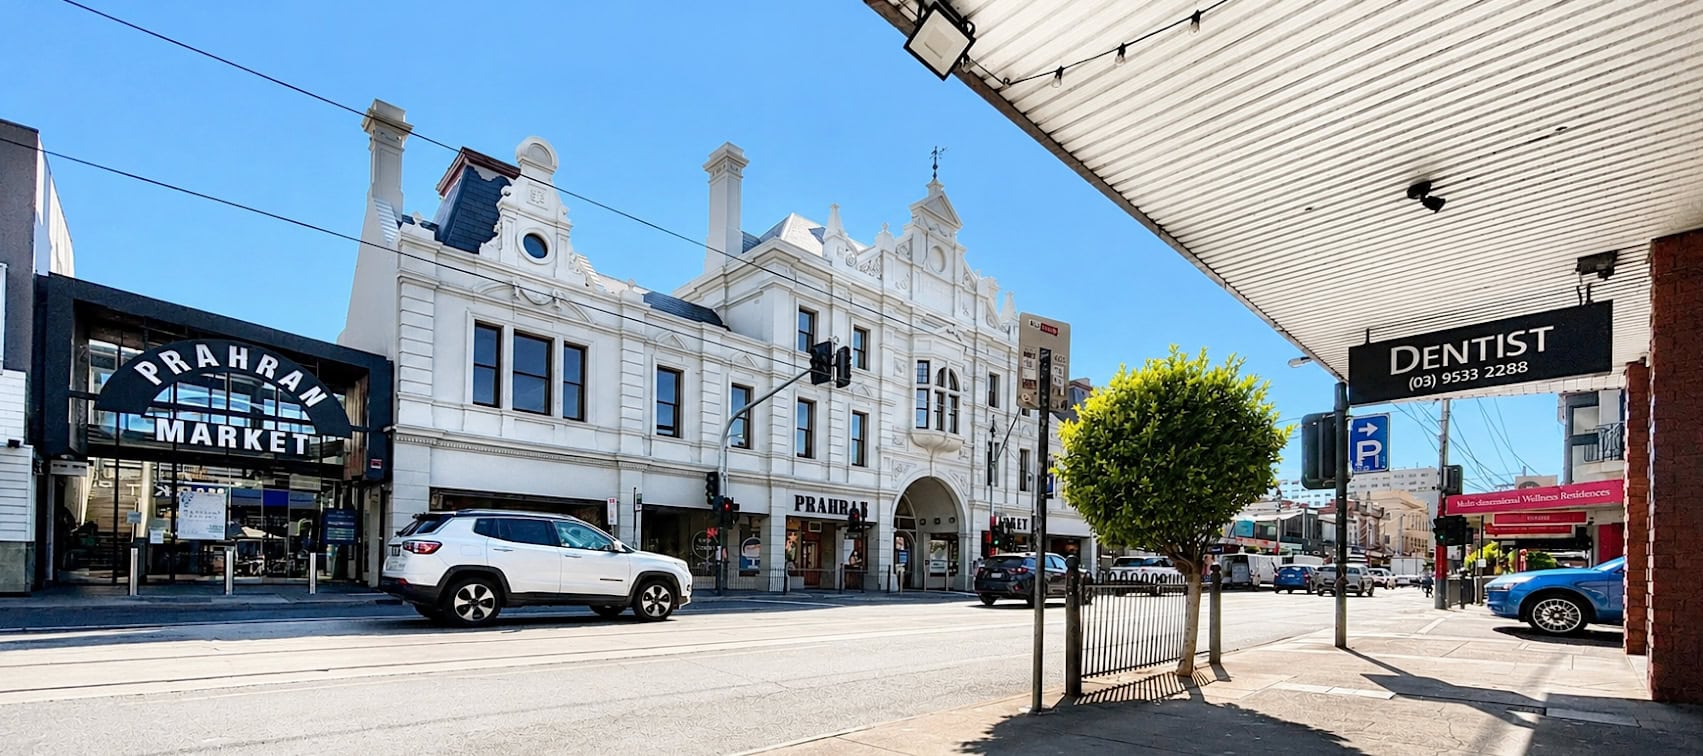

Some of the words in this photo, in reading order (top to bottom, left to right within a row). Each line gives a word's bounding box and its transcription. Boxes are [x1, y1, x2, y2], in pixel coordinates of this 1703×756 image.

[1390, 325, 1555, 376] DENTIST
[134, 343, 329, 409] PRAHRAN
[1408, 373, 1438, 392] (03)
[1441, 368, 1479, 385] 9533
[1484, 360, 1529, 379] 2288
[155, 418, 310, 455] MARKET
[1356, 440, 1383, 468] P
[1522, 493, 1559, 504] Wellness
[1560, 488, 1611, 501] Residences
